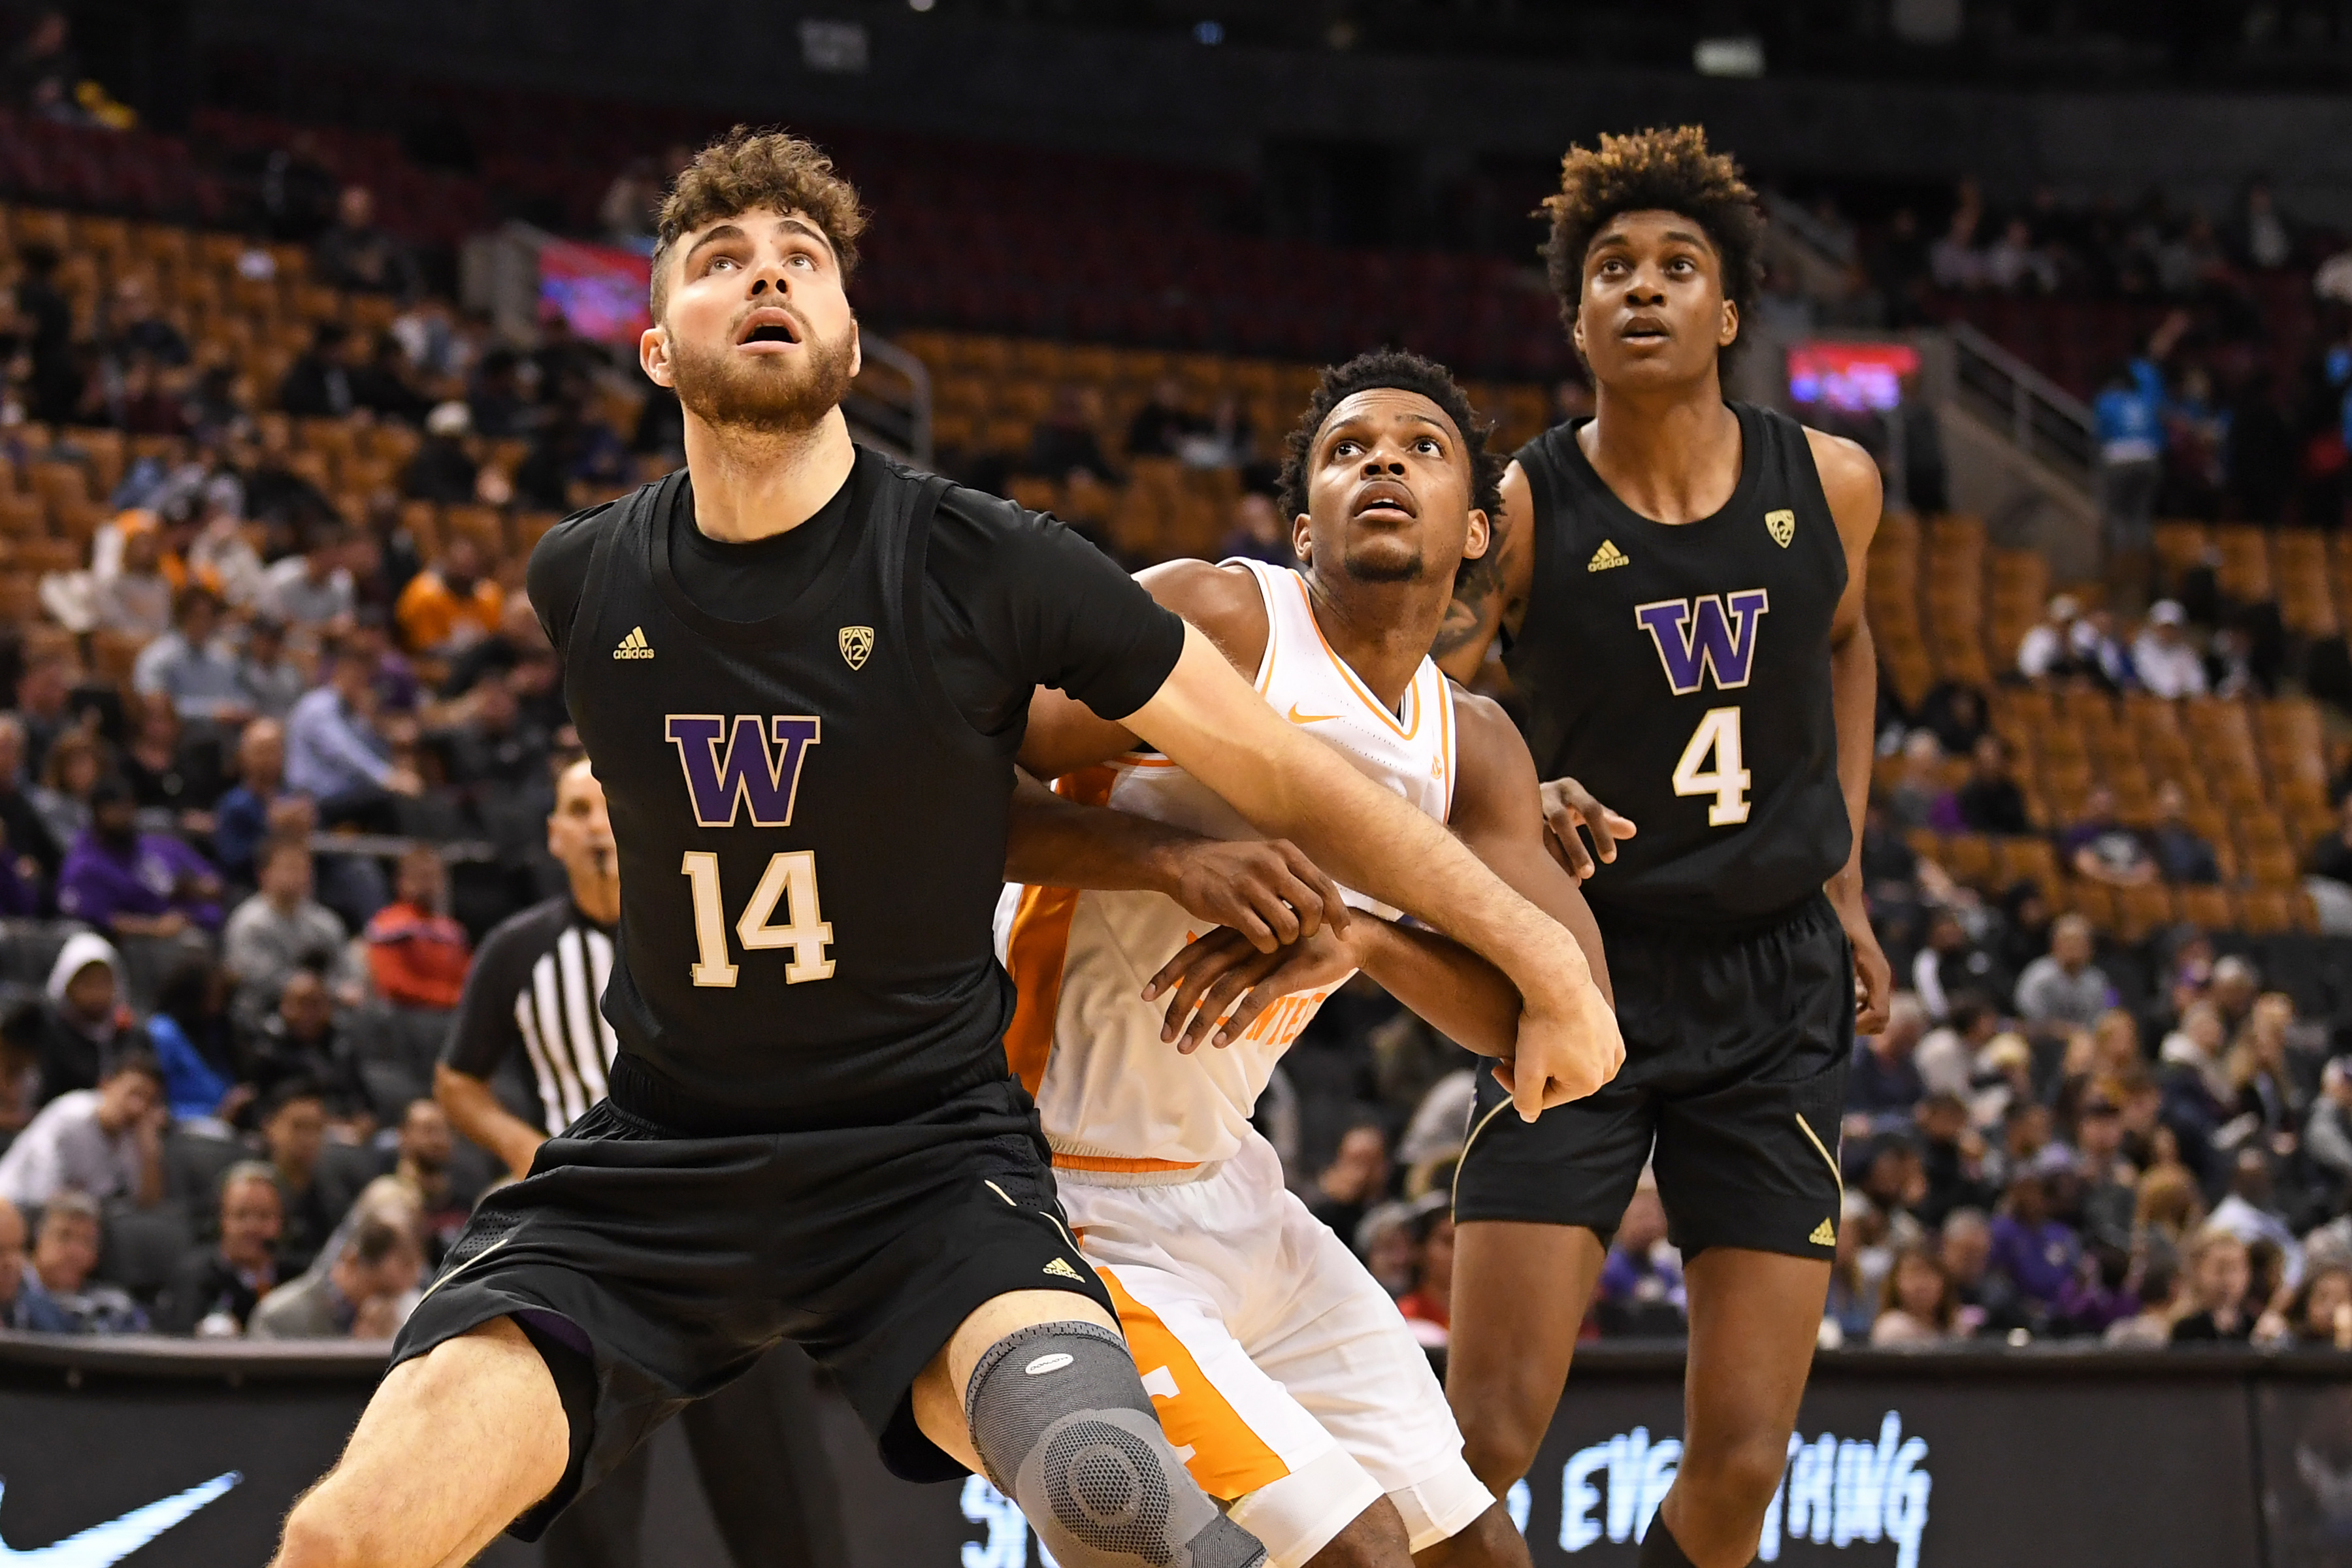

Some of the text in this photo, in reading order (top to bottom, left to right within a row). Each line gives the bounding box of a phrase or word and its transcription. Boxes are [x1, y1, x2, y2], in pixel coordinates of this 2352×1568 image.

[1588, 555, 1629, 572] adidas
[841, 628, 872, 652] PAC
[1635, 588, 1769, 696] W
[613, 647, 655, 660] adidas
[848, 645, 865, 661] 12
[665, 714, 821, 827] W
[1672, 706, 1752, 828] 4
[681, 850, 836, 987] 14
[1042, 1267, 1086, 1284] adidas
